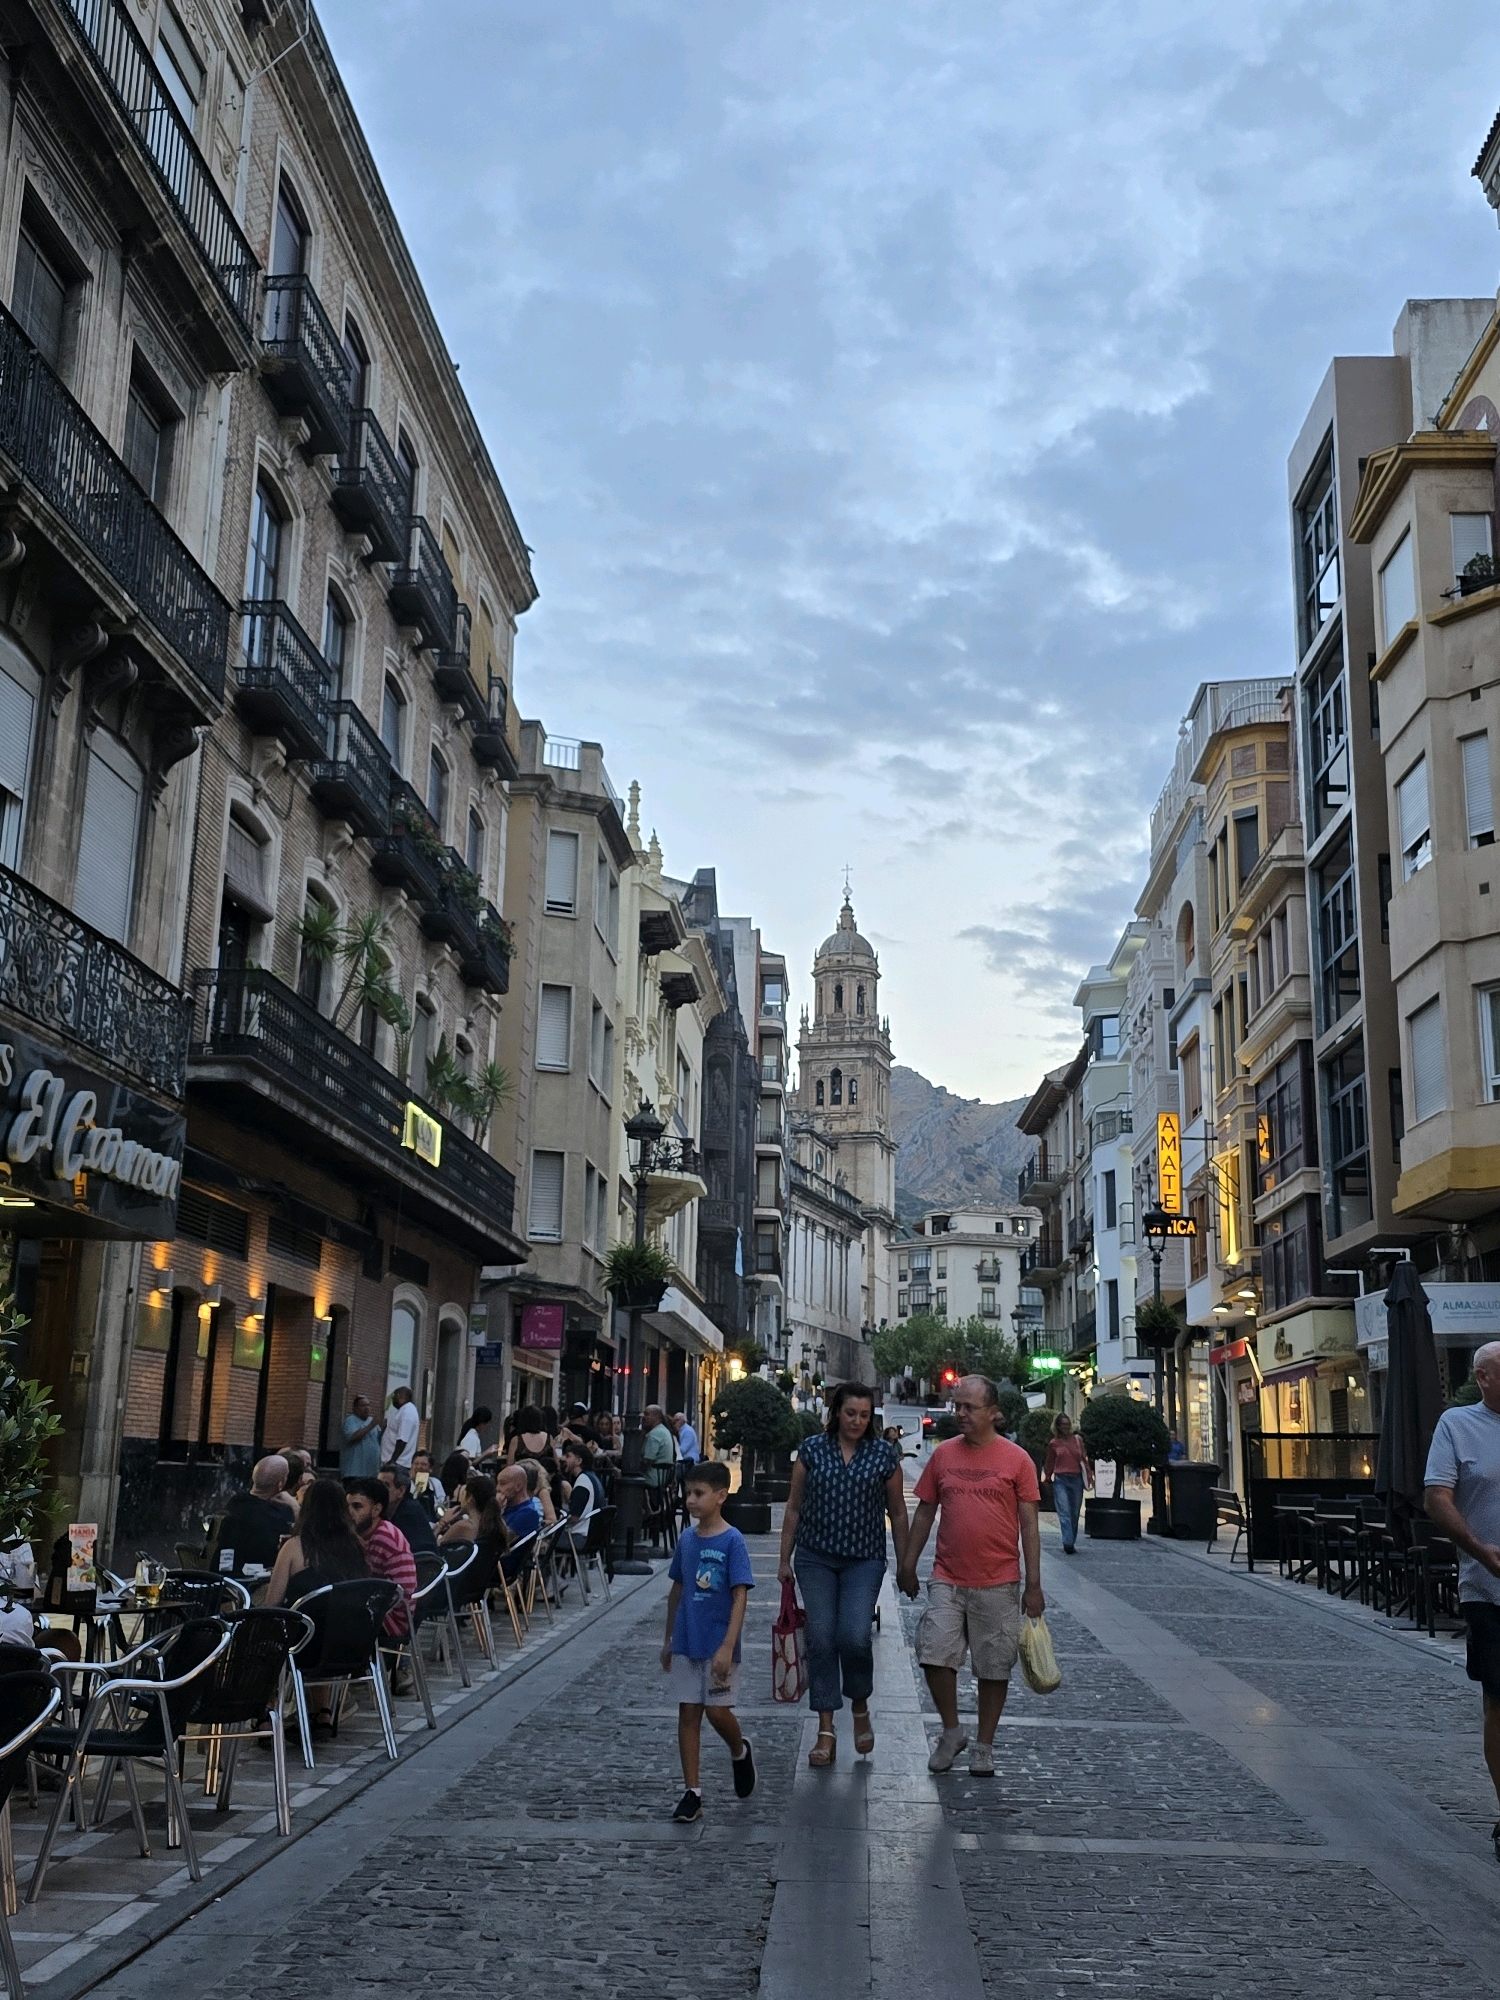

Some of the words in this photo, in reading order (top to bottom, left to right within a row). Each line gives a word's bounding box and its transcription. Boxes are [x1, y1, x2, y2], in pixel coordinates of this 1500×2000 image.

[7, 1069, 65, 1163] El
[53, 1091, 180, 1200] Carmen
[1160, 1116, 1177, 1210] AMATE
[1149, 1219, 1197, 1235] TICA
[1442, 1300, 1500, 1311] ALMASALUD
[968, 1487, 1005, 1499] MARTIN
[700, 1548, 727, 1562] SONIC
